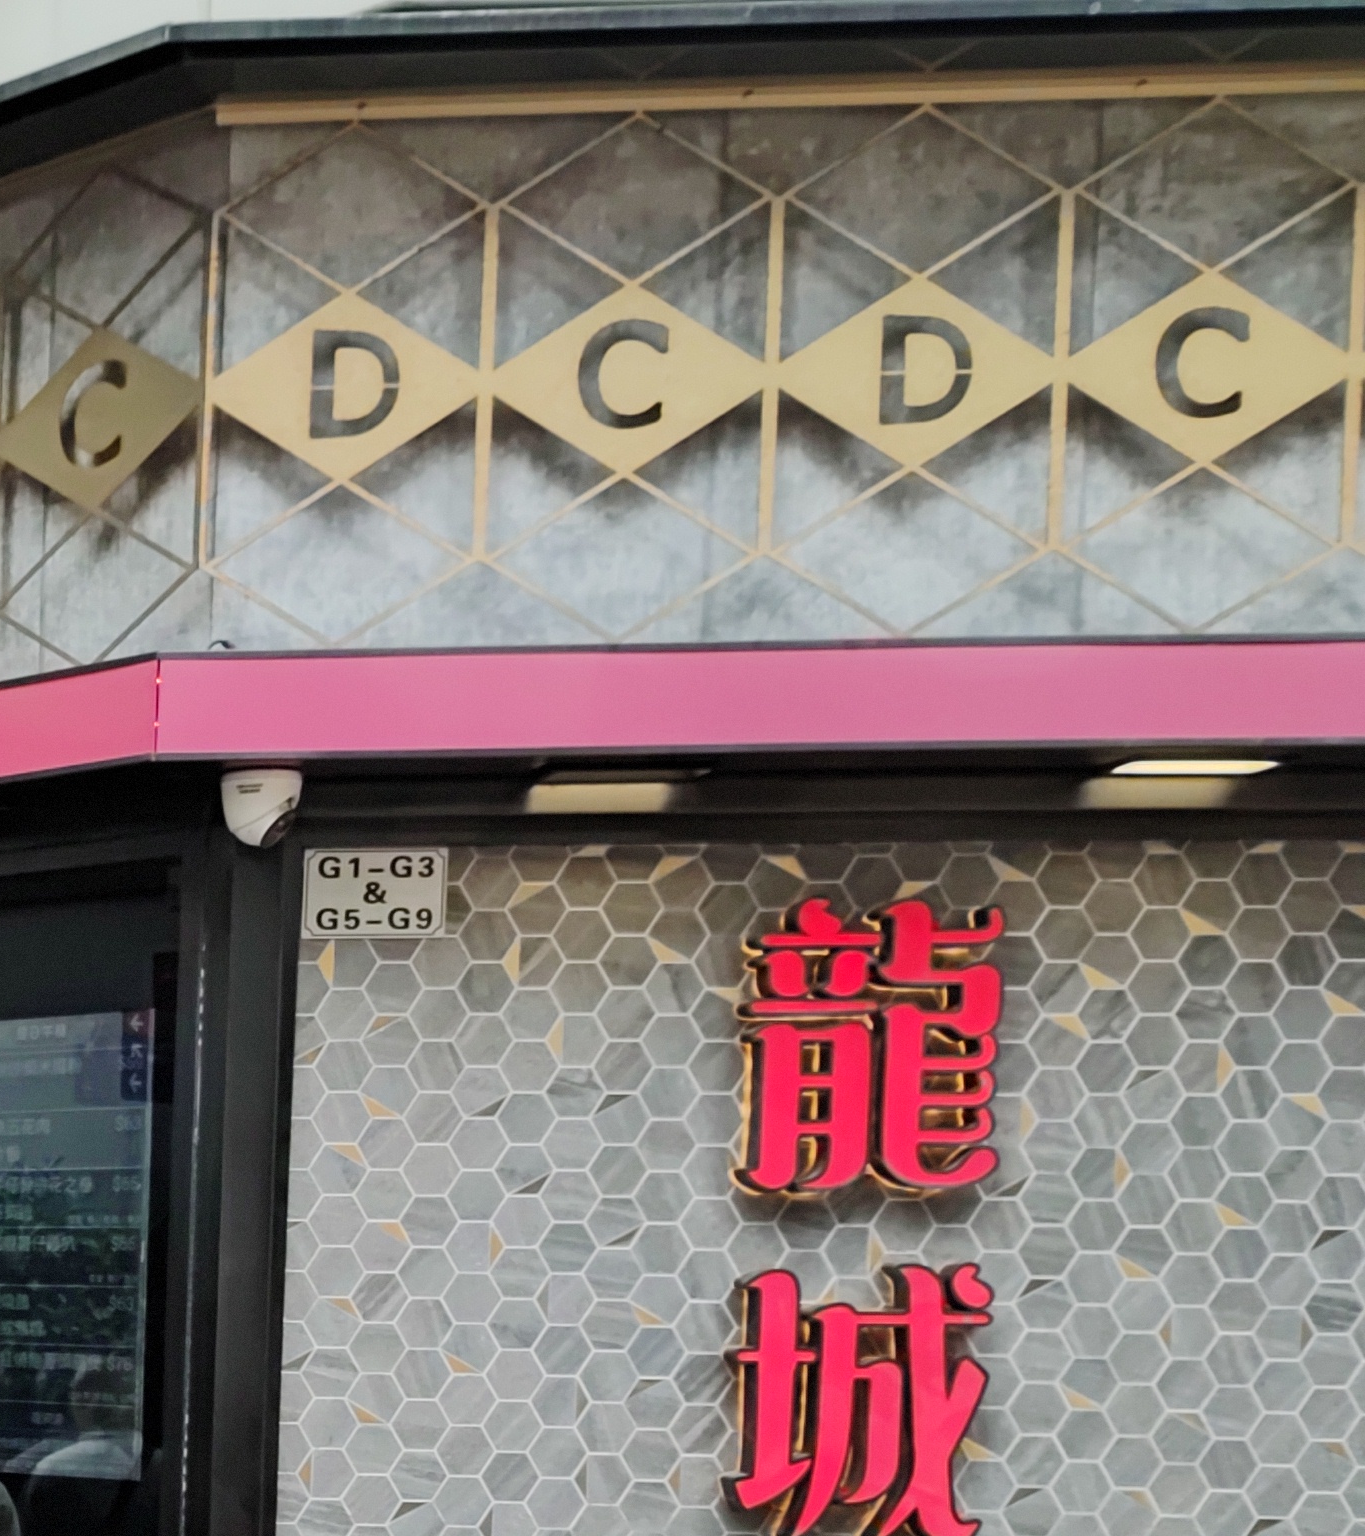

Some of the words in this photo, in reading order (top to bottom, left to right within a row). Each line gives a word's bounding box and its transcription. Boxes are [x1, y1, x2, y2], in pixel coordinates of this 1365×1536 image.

[317, 855, 436, 880] G1-G3
[362, 881, 388, 904] &
[315, 907, 434, 931] G5-G9
